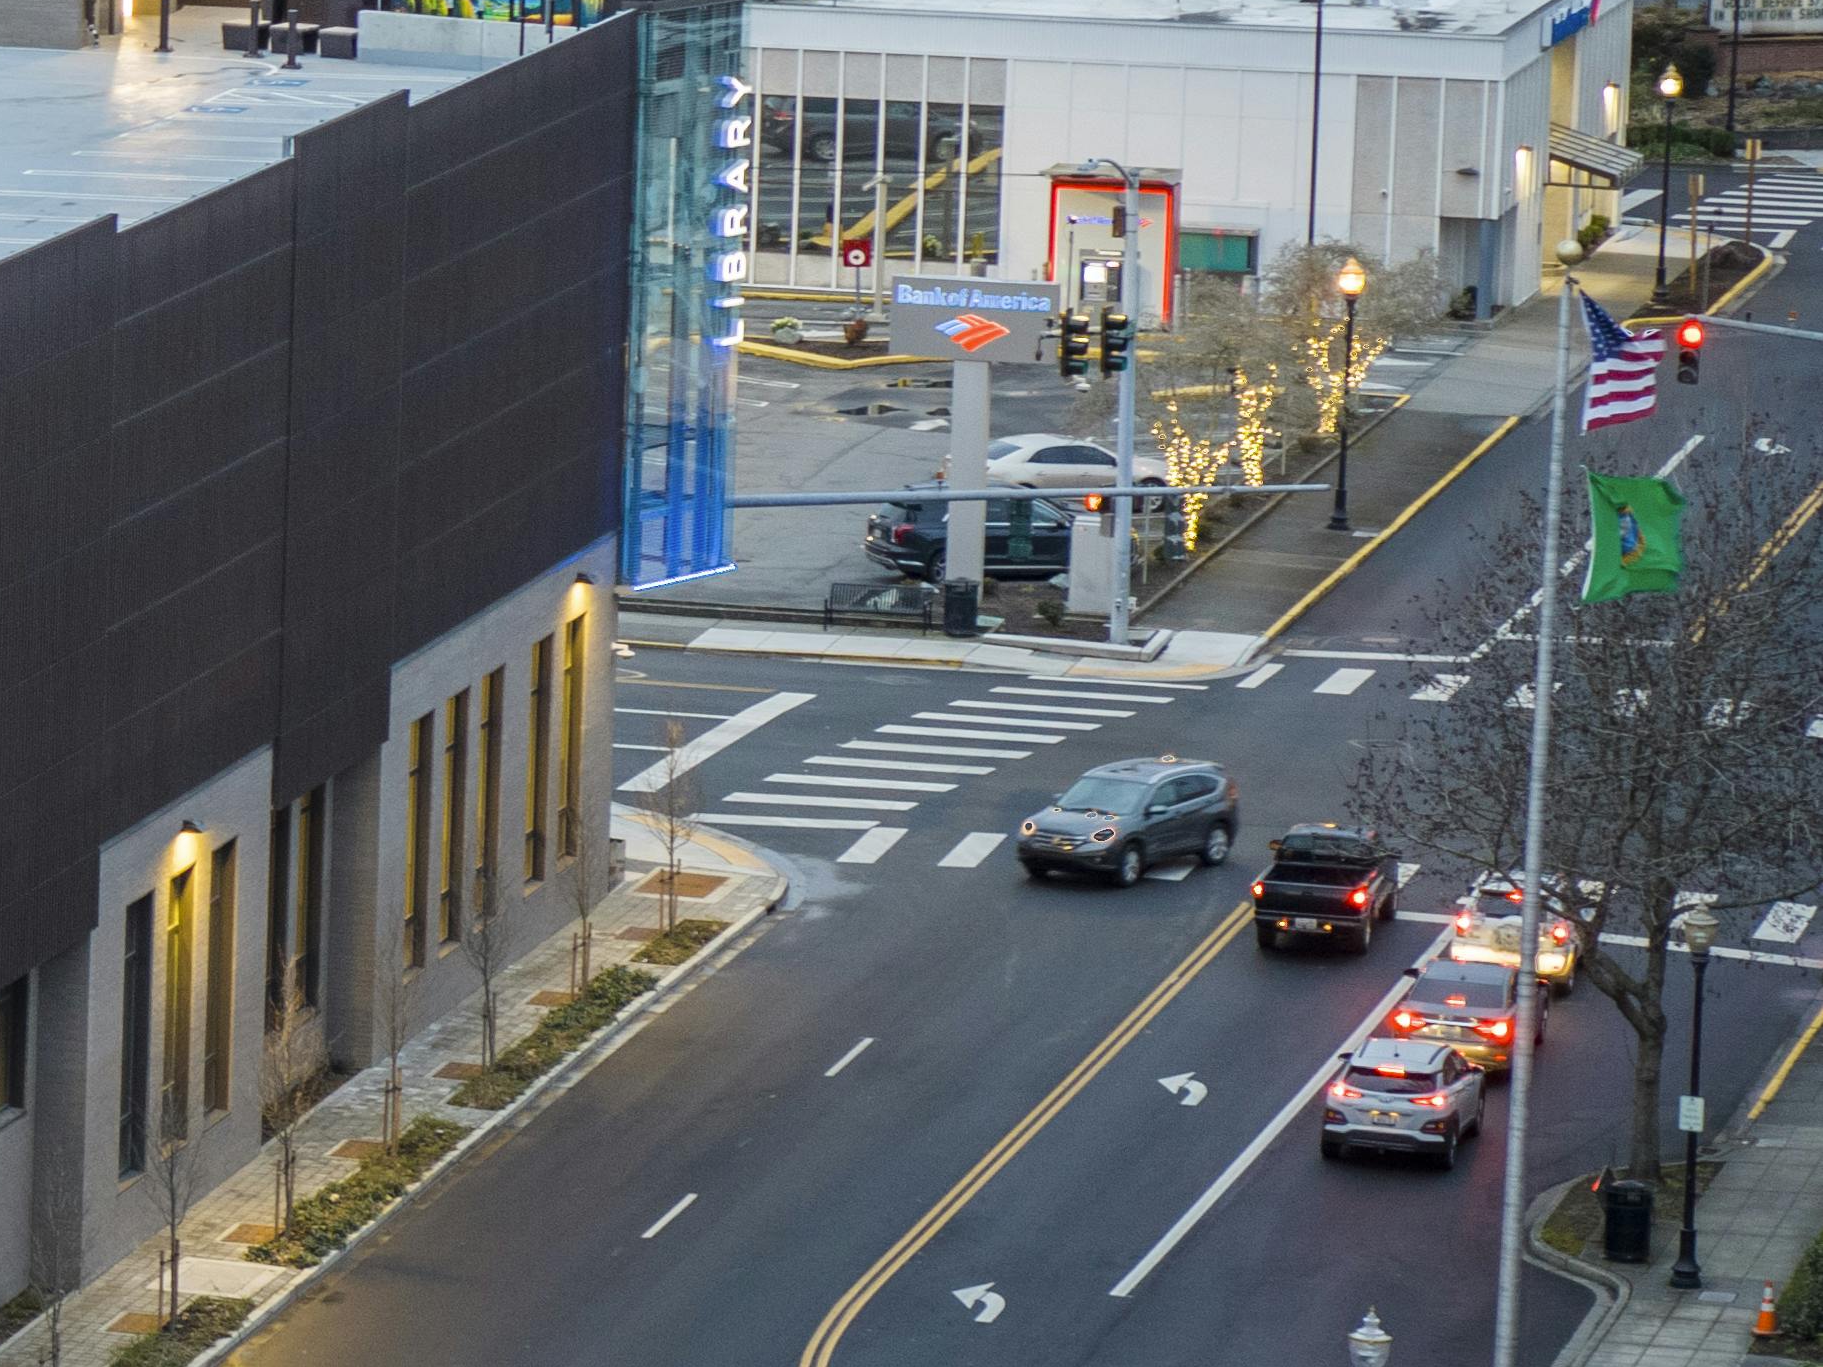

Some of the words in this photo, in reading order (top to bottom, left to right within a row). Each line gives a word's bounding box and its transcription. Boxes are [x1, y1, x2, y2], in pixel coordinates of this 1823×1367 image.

[708, 75, 753, 349] LIBRARY
[896, 284, 947, 306] Bank
[946, 287, 969, 308] of
[969, 289, 1051, 312] America
